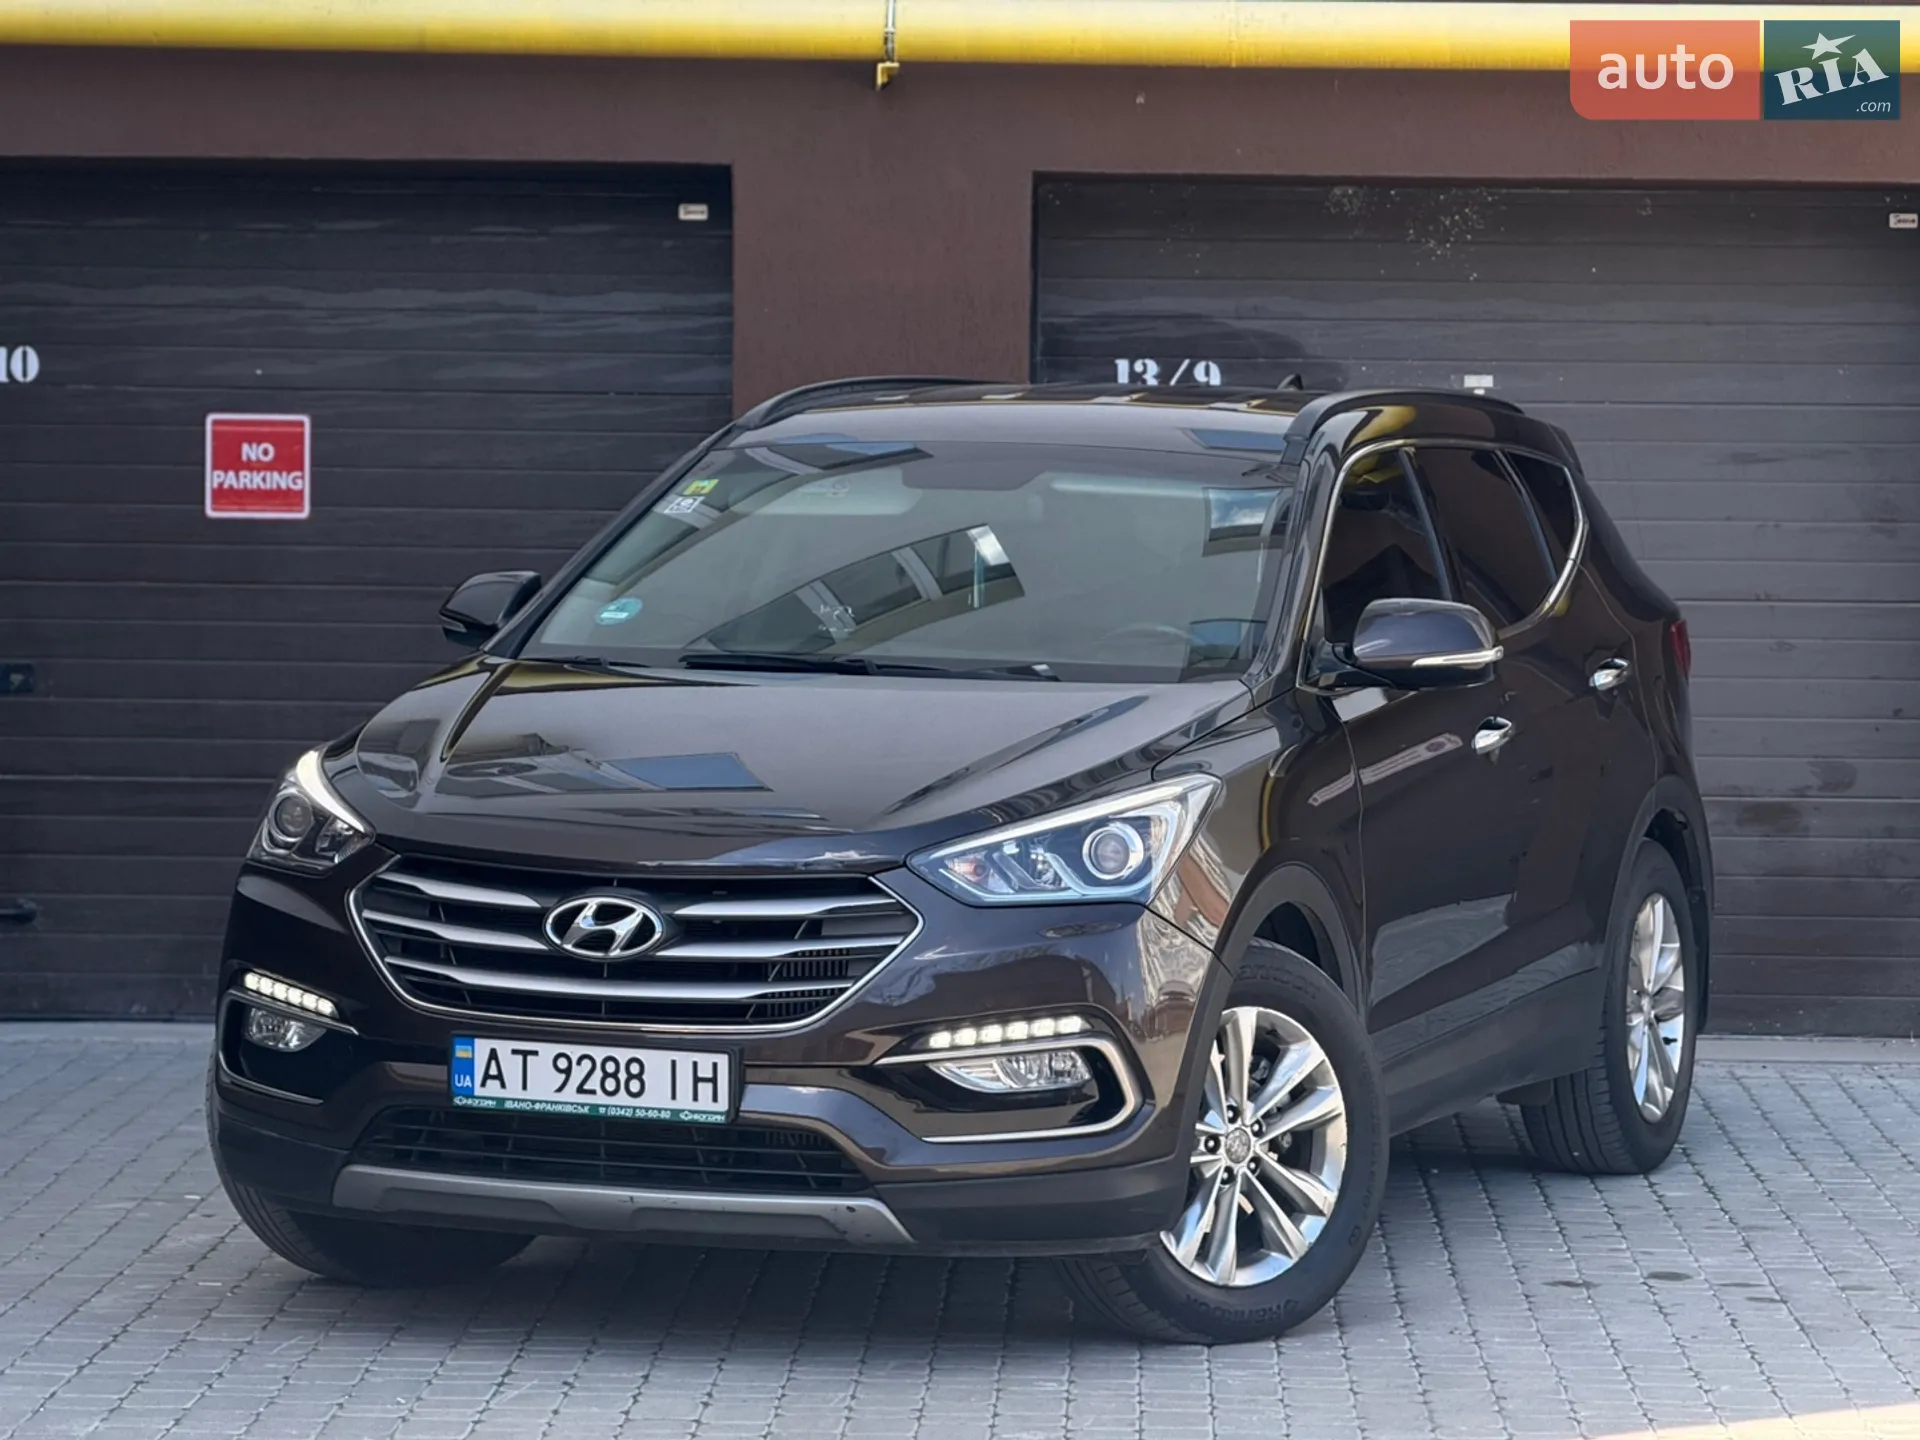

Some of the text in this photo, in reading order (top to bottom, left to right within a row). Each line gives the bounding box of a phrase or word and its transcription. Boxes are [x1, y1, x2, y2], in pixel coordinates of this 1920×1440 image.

[241, 442, 275, 462] NO
[212, 470, 304, 491] PARKING
[454, 1073, 473, 1088] UA
[479, 1047, 719, 1104] AT 9288 IH
[607, 1105, 633, 1118] (0342)
